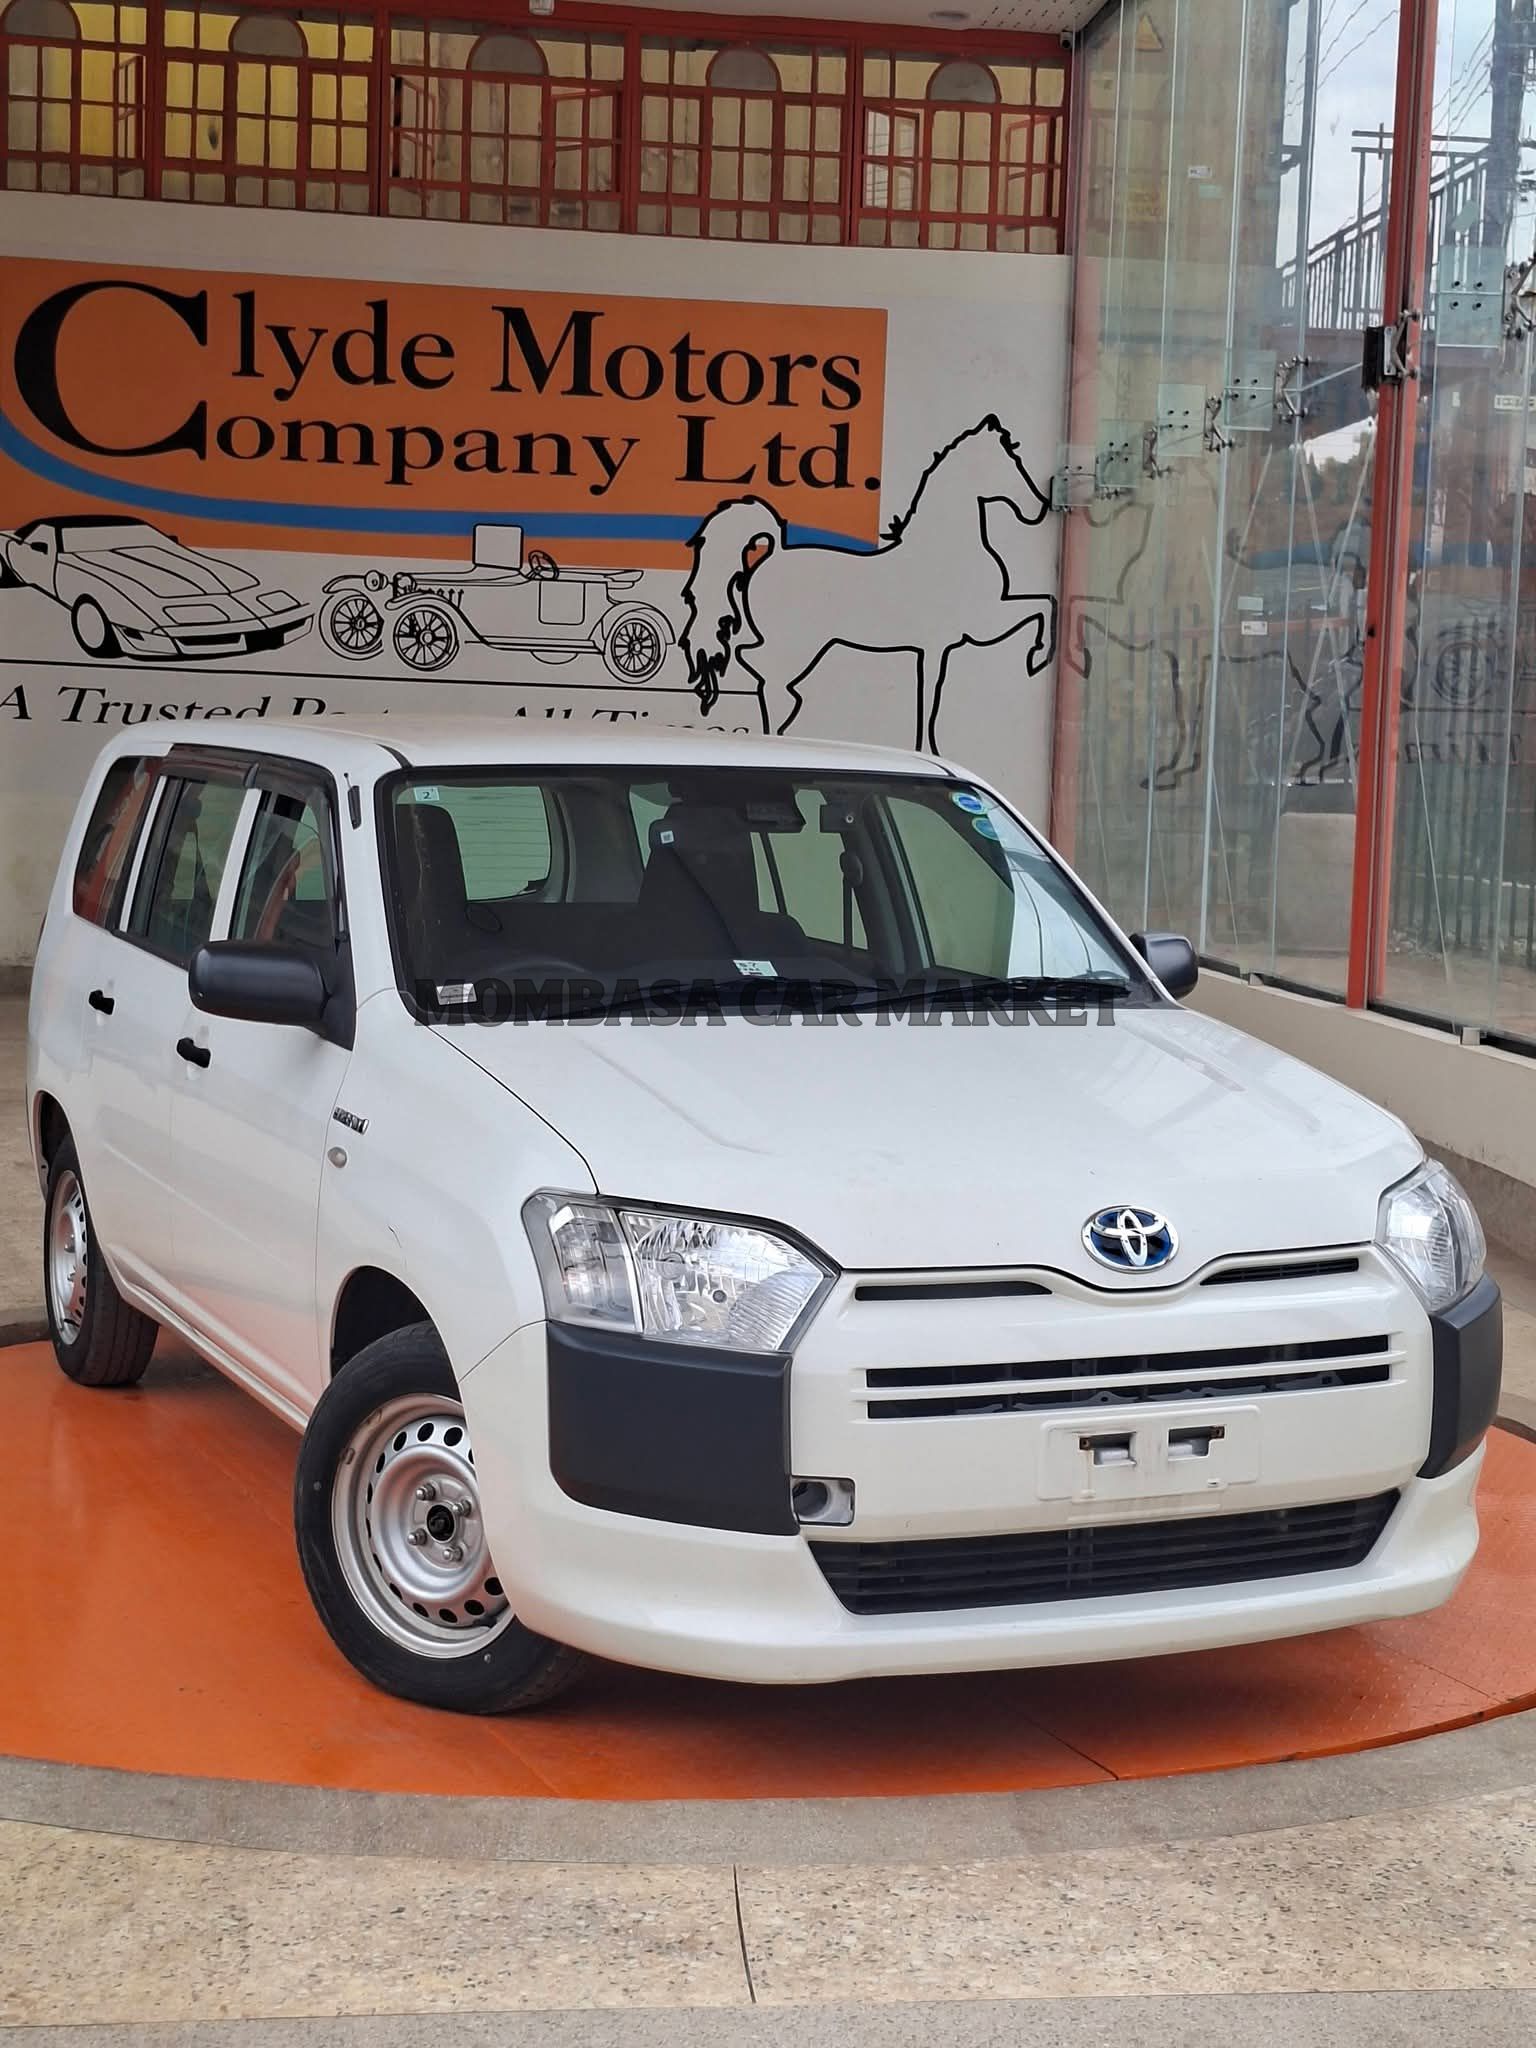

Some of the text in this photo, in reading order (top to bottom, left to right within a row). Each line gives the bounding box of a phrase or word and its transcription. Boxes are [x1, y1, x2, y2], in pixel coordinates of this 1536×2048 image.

[14, 280, 862, 461] Clyde Motors
[675, 415, 881, 491] Ltd.
[0, 684, 33, 720] A
